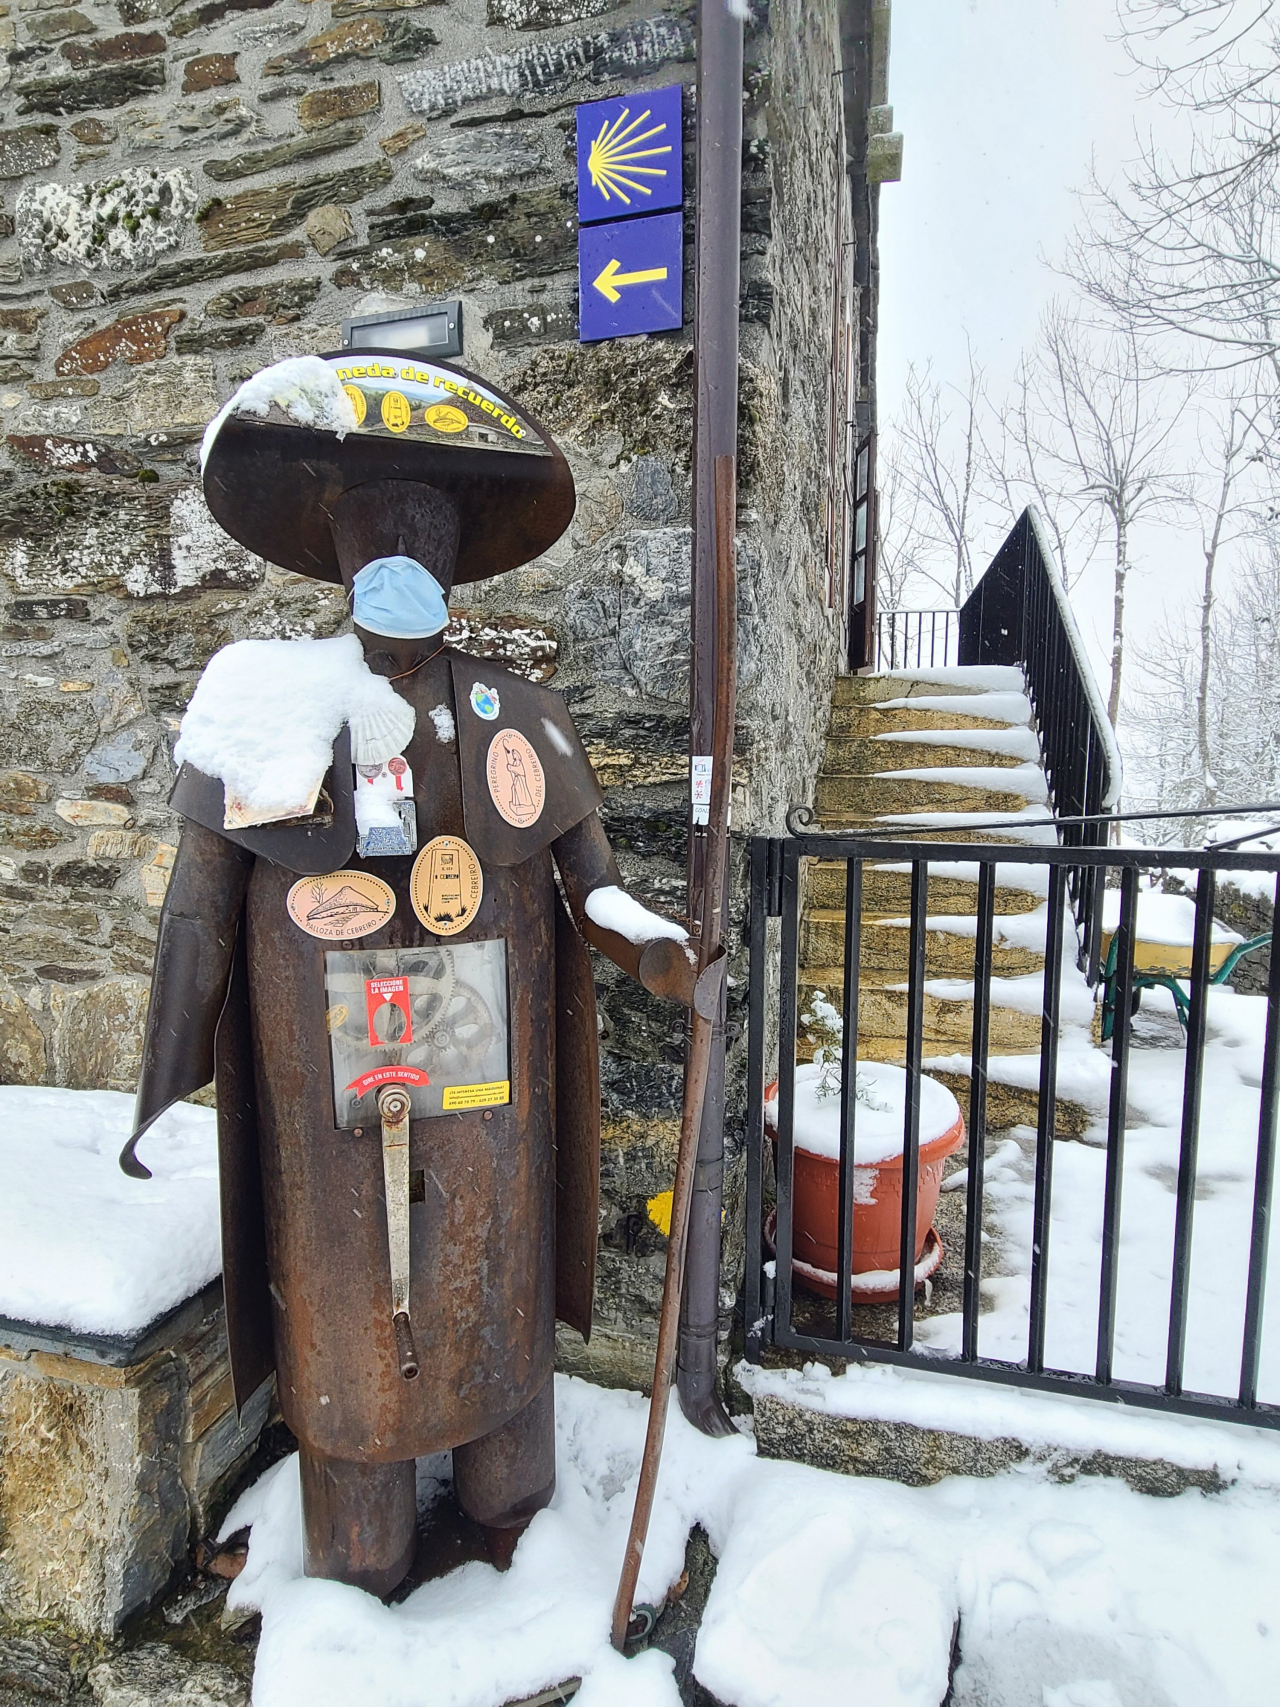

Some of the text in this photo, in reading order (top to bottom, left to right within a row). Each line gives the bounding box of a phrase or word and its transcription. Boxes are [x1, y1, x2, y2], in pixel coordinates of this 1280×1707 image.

[336, 363, 525, 440] neda de recuerdo
[491, 751, 501, 794] PEREGRINO
[525, 749, 543, 798] DEL CEBREIRO
[468, 863, 479, 900] CEBREIRO
[305, 922, 333, 935] PALLOZA
[346, 919, 377, 935] CEBREIRO
[370, 979, 404, 988] SELECCIONE
[371, 985, 404, 995] LA IMAGEN
[362, 1071, 420, 1086] GIRE EN ESTE SENTIDO
